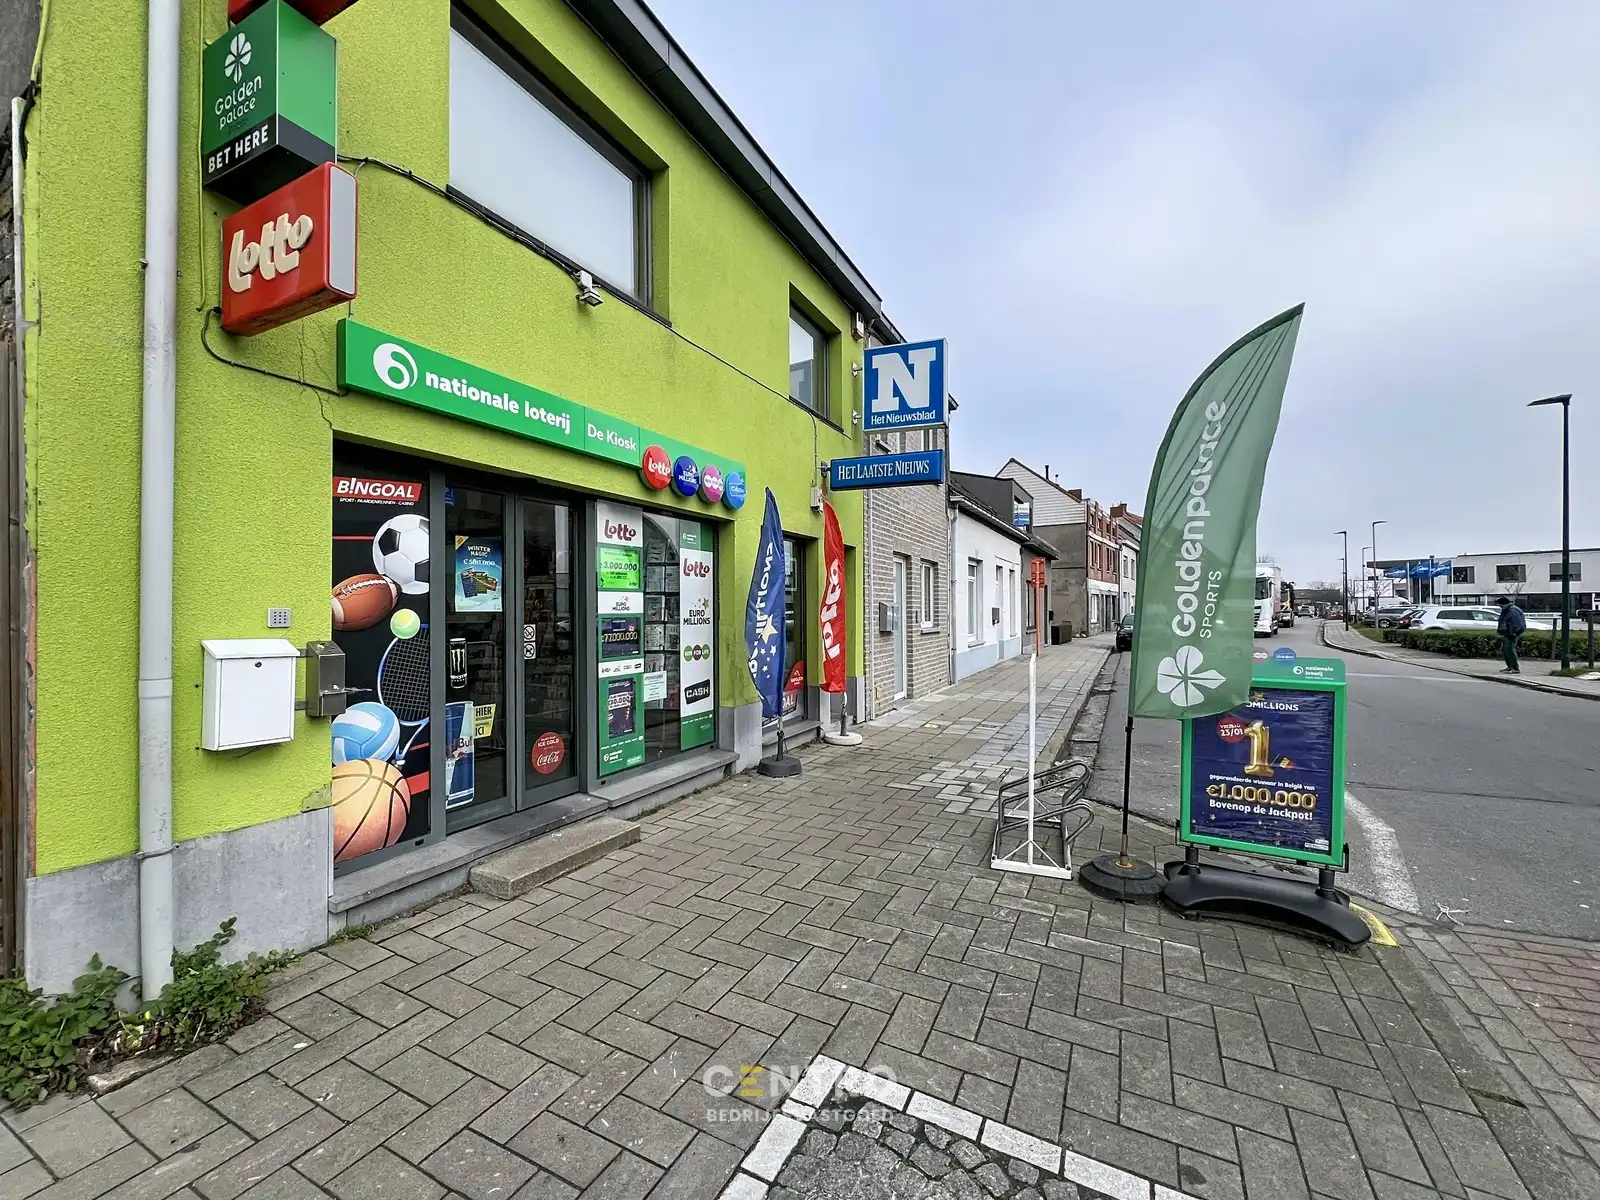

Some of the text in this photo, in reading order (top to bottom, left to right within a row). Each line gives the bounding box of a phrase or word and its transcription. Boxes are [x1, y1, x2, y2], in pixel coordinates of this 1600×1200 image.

[219, 96, 256, 130] palace
[208, 124, 269, 173] BET HERE
[872, 347, 936, 413] N
[426, 370, 571, 435] nationale loterij
[871, 409, 936, 425] Het Nieuwsblad
[587, 422, 637, 452] De Kiosk
[468, 545, 491, 553] WINTER
[1200, 569, 1222, 639] SPORTS
[683, 617, 711, 625] MILLIONS
[686, 686, 709, 698] CASH
[475, 706, 492, 717] HIER
[475, 726, 485, 737] ICI
[1220, 728, 1244, 737] 23/01
[546, 738, 560, 746] COLD
[1209, 774, 1252, 784] gegarandeerde
[1252, 779, 1277, 787] winnaar
[1284, 781, 1303, 791] België
[1209, 799, 1314, 820] Bovenop de Jackpot!
